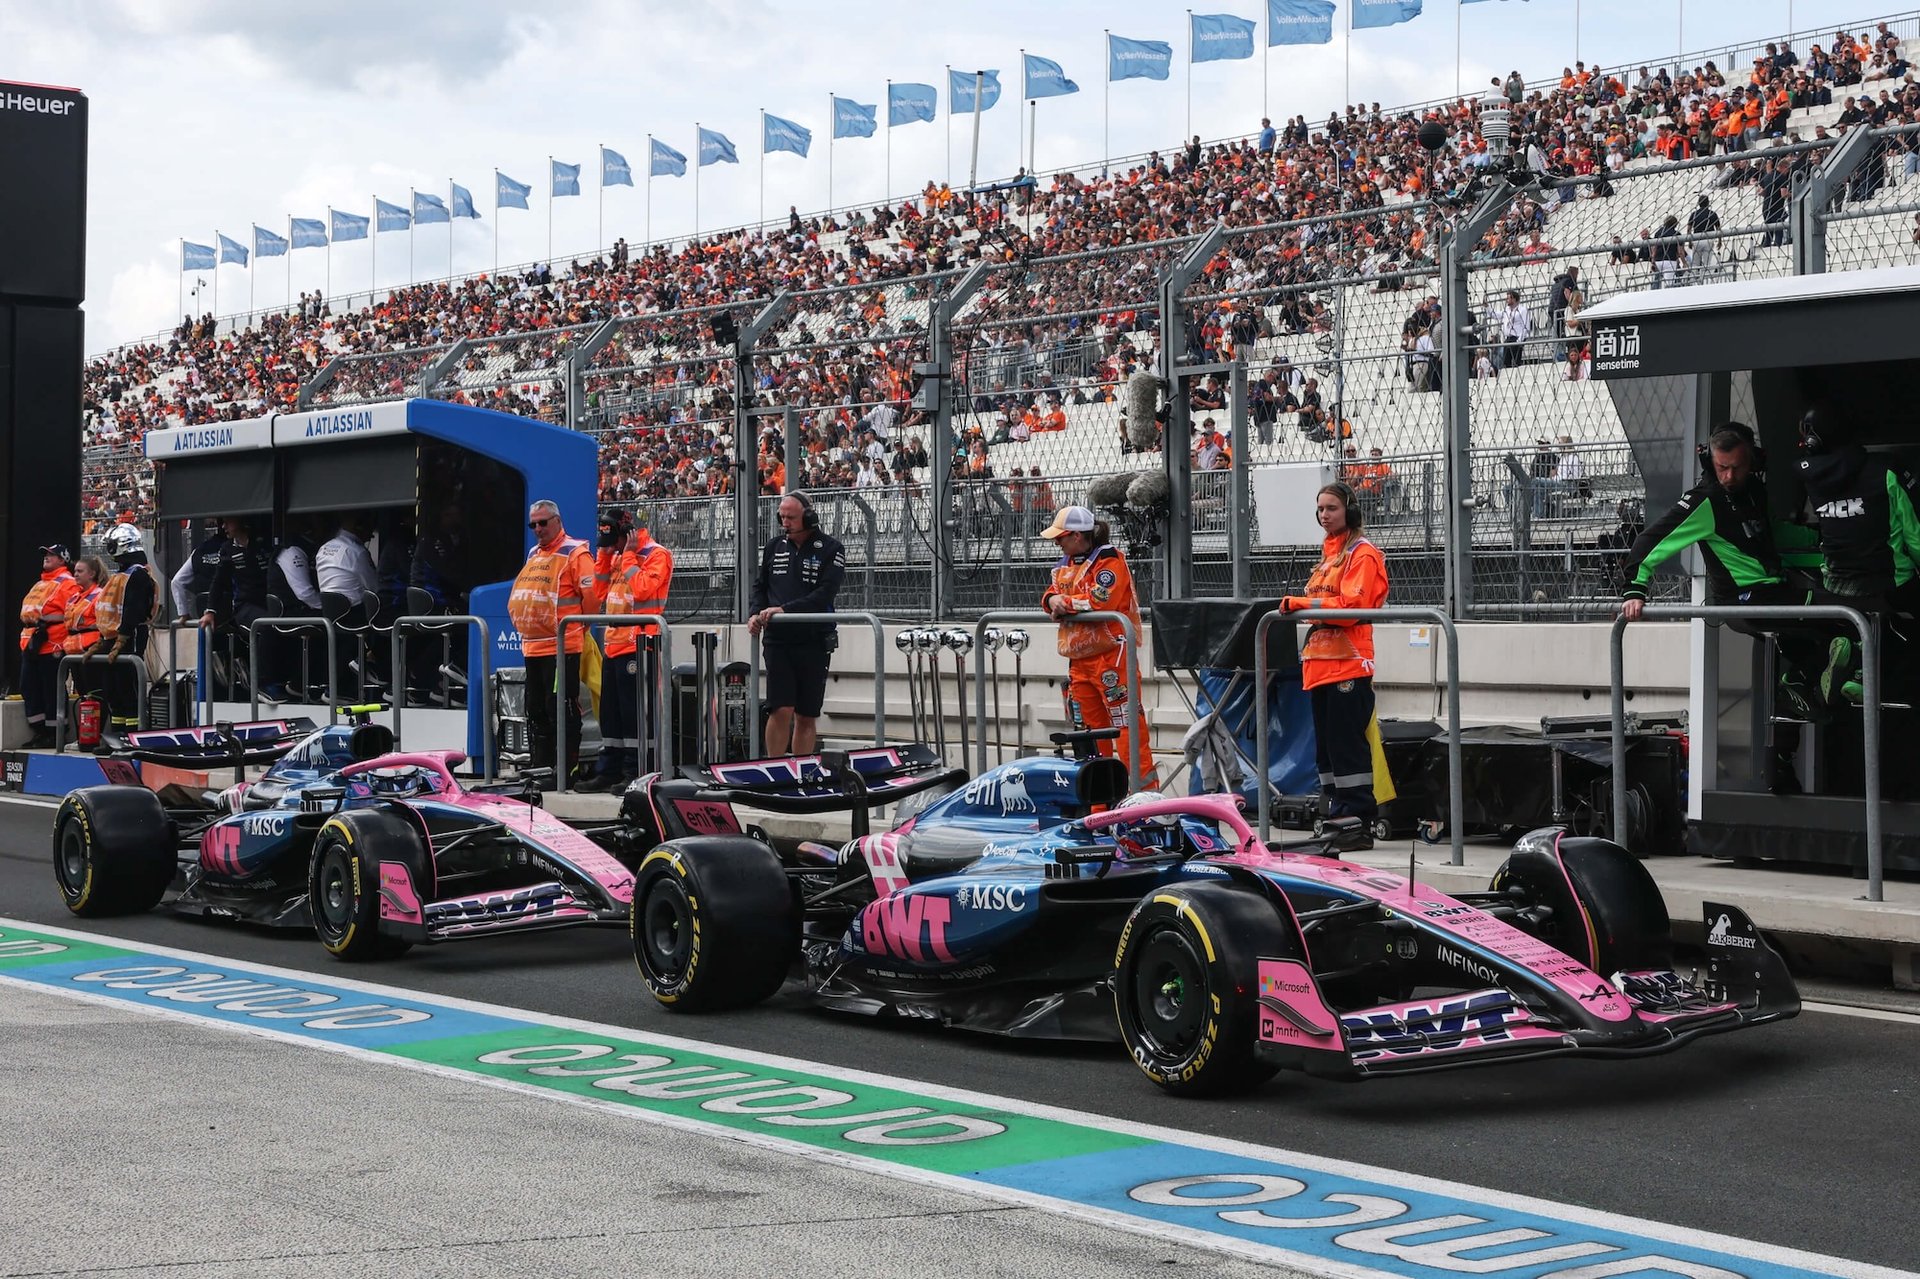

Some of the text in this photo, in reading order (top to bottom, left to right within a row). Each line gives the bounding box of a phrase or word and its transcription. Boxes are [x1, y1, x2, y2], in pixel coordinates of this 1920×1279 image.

[1276, 14, 1329, 26] VolkerWessels
[1200, 30, 1249, 42] VolkerWessels
[1116, 51, 1168, 62] VolkerWessels
[7, 92, 76, 116] Heuer
[1596, 358, 1640, 371] sensetime
[315, 411, 373, 436] ATLASSIAN
[182, 428, 233, 450] ATLASSIAN
[6, 761, 24, 772] SEASON
[7, 772, 23, 783] FINALE
[964, 777, 997, 806] eni
[251, 816, 285, 837] MSC
[686, 807, 712, 828] eni
[532, 852, 565, 881] INFINOX
[972, 883, 1027, 913] MSC
[1422, 906, 1473, 919] BWT
[863, 892, 960, 965] BWT
[686, 895, 701, 984] P ZERO
[1707, 932, 1757, 949] OAKBERRY
[952, 963, 997, 980] Delphi
[1436, 944, 1500, 984] INFINOX
[72, 966, 433, 1029] aramco
[1274, 979, 1311, 995] Microsoft
[1181, 992, 1221, 1083] P ZERO
[1275, 1025, 1300, 1039] mntn
[477, 1043, 1008, 1146] aramco
[1128, 1173, 1752, 1279] mco
